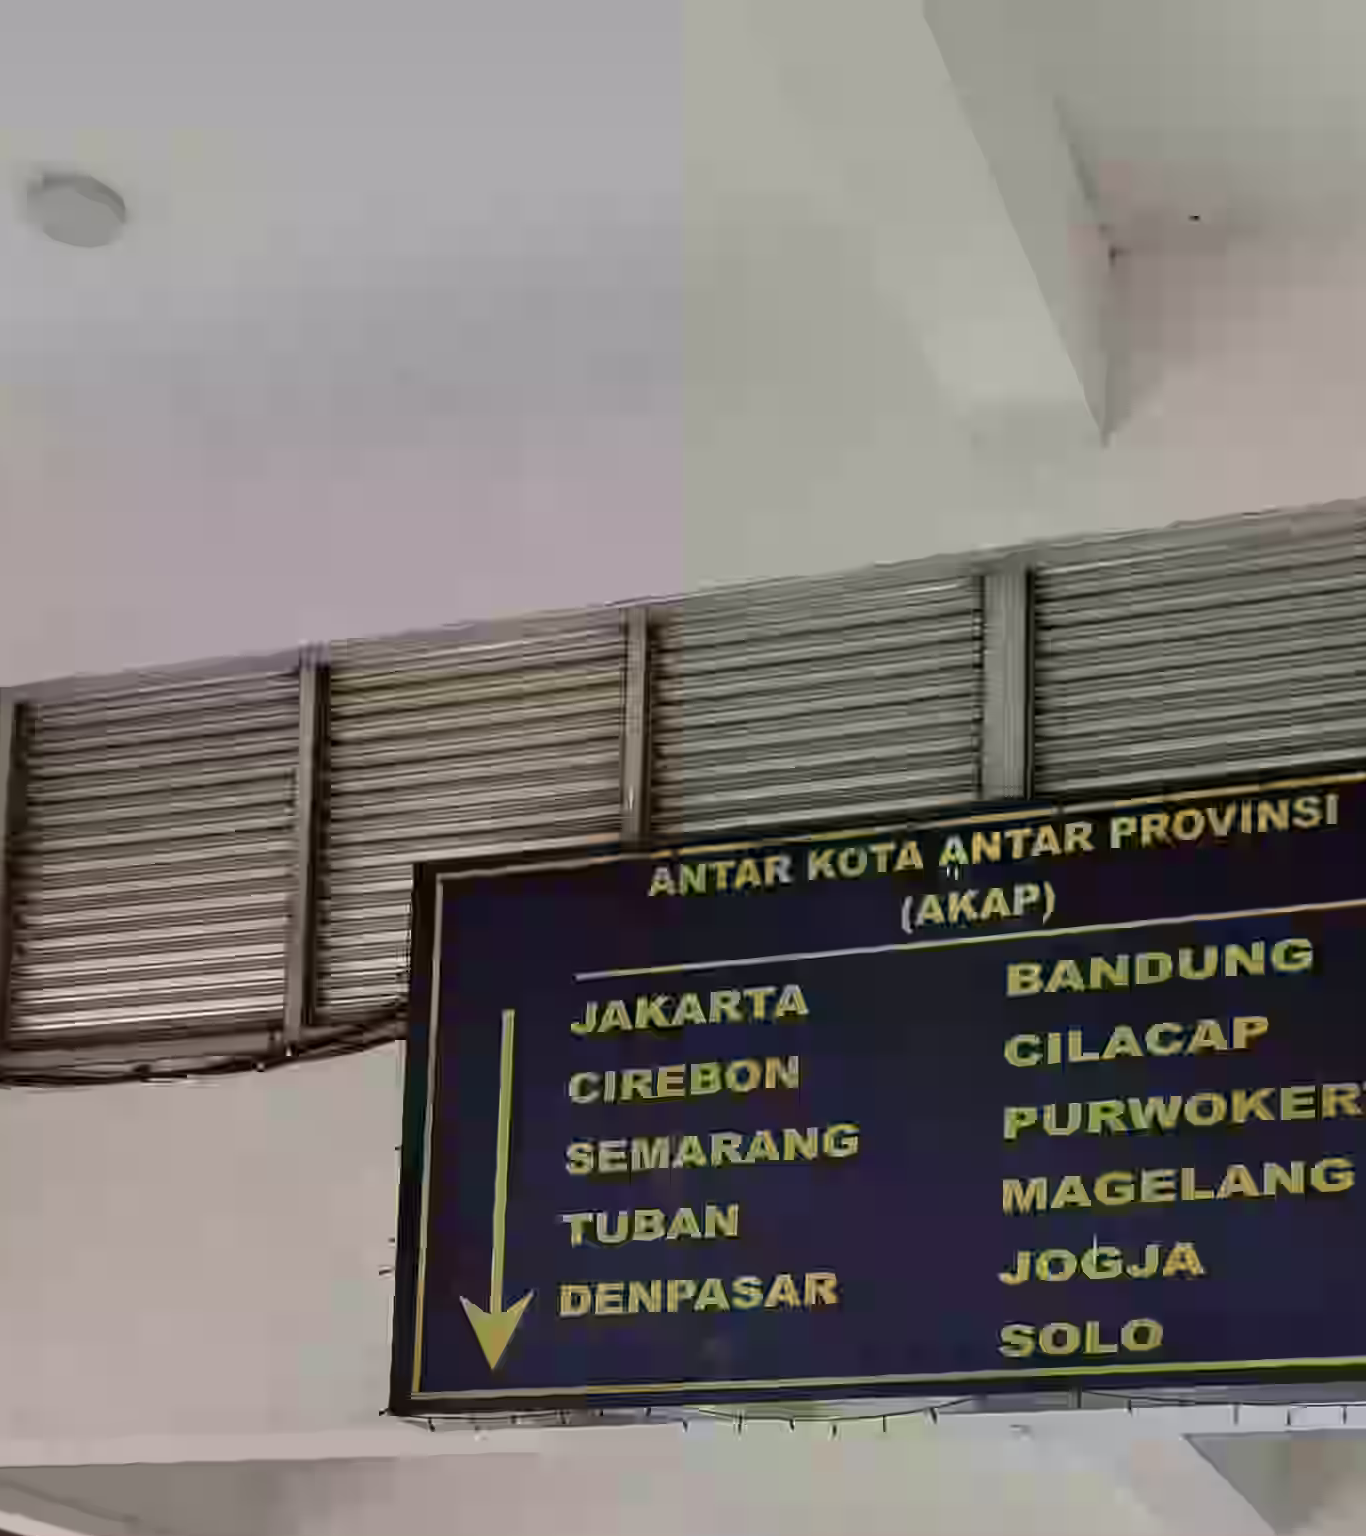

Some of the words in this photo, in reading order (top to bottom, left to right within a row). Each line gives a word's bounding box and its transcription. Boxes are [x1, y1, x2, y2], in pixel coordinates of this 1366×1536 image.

[648, 854, 791, 897] ANTAR
[807, 838, 925, 882] KOTA
[939, 820, 1094, 868] ANTAR
[1109, 795, 1339, 850] PROVINSI
[900, 880, 1056, 933] (AKAP)
[1005, 937, 1314, 997] BANDUNG
[570, 984, 810, 1034] JAKARTA
[1003, 1015, 1270, 1068] CILACAP
[567, 1055, 800, 1104] CIREBON
[565, 1123, 861, 1176] SEMARANG
[1001, 1156, 1356, 1215] MAGELANG
[561, 1203, 741, 1247] TUBAN
[997, 1240, 1207, 1286] JOGJA
[558, 1271, 841, 1318] DENPASAR
[998, 1317, 1165, 1358] SOLO
